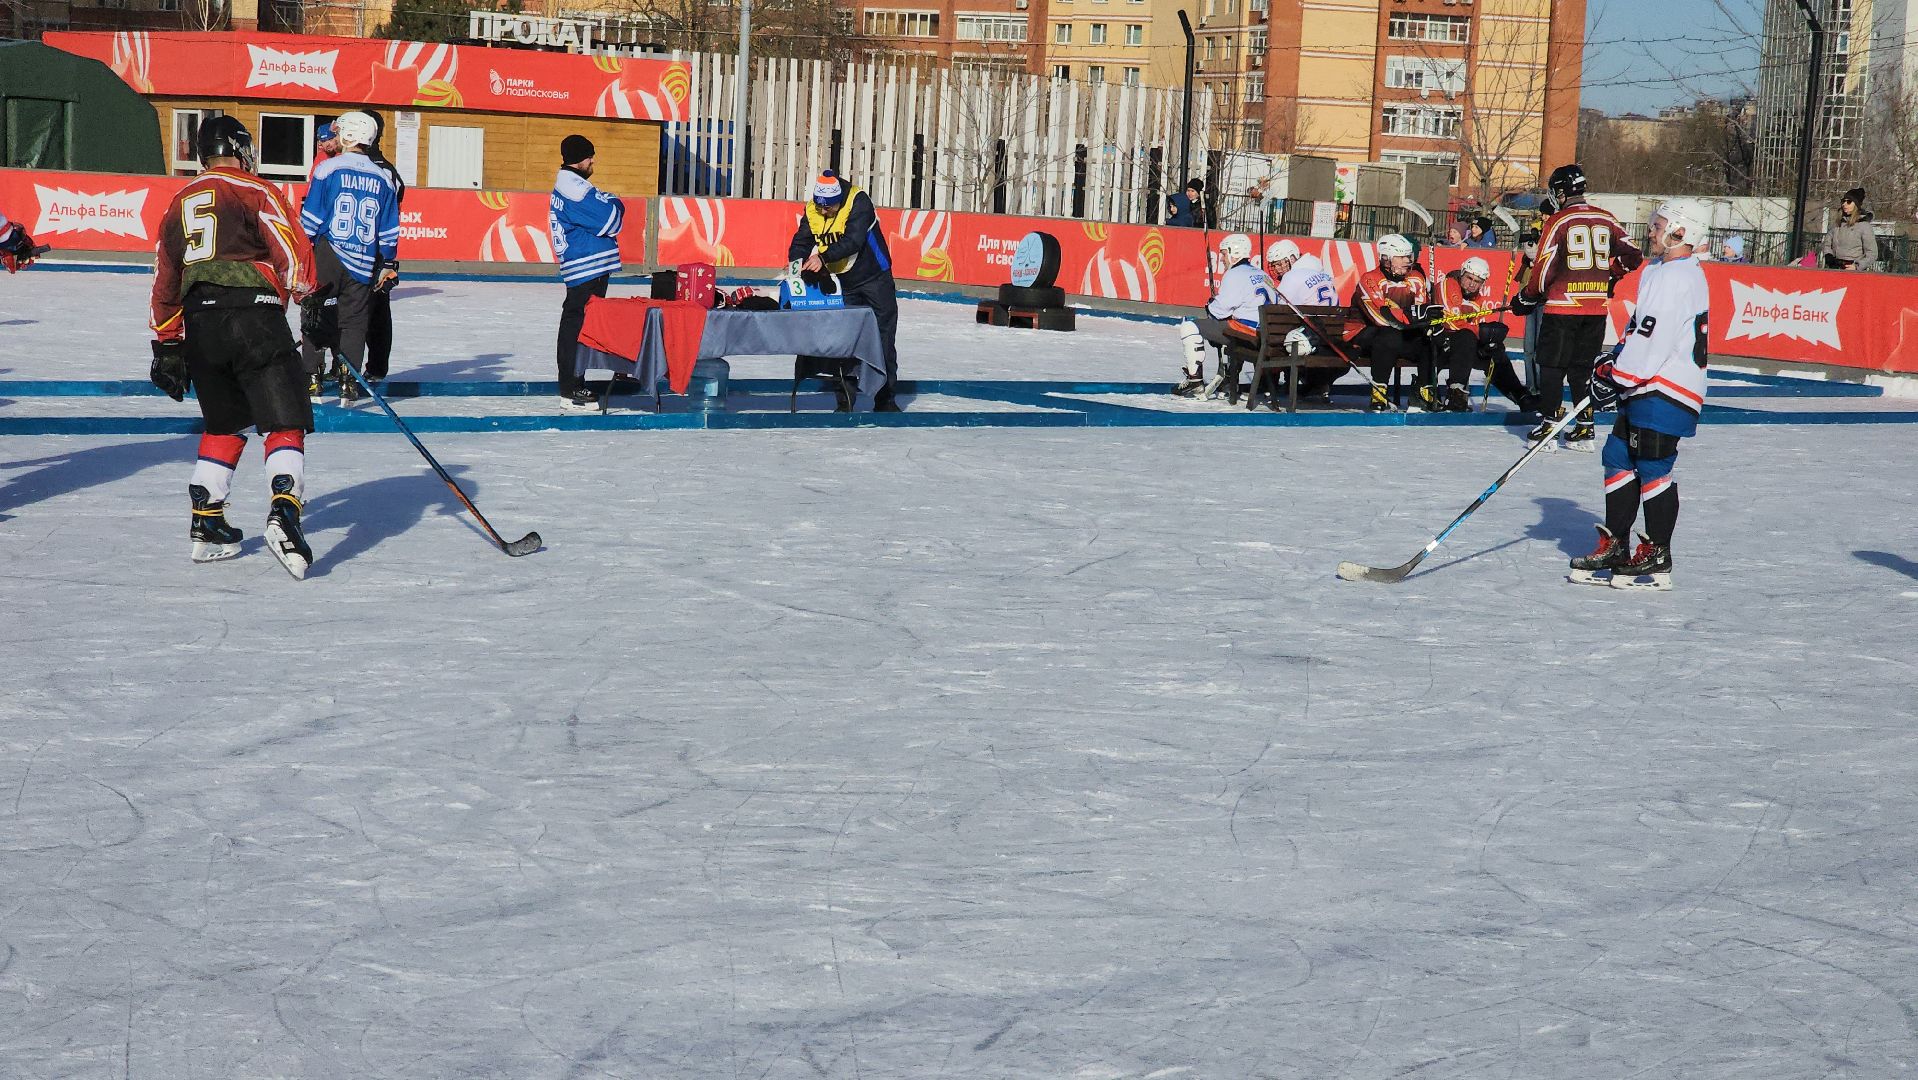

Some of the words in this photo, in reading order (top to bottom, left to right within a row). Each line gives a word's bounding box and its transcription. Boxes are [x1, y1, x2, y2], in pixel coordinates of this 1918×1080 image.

[469, 10, 598, 55] ПРОКАТ
[259, 60, 296, 75] Альфа
[299, 62, 328, 75] Банк
[506, 78, 534, 88] ПАРКИ
[506, 87, 570, 99] ПОДМОСКОВЬЯ
[340, 173, 381, 195] ШАНИН
[49, 202, 96, 221] Альфа
[99, 204, 135, 219] Банк
[328, 192, 380, 244] 89
[181, 189, 218, 266] 5
[977, 234, 999, 251] Для
[1567, 224, 1611, 270] 99
[986, 253, 994, 264] и
[792, 280, 803, 295] 3
[1742, 301, 1789, 324] Альфа
[1792, 305, 1830, 323] Банк
